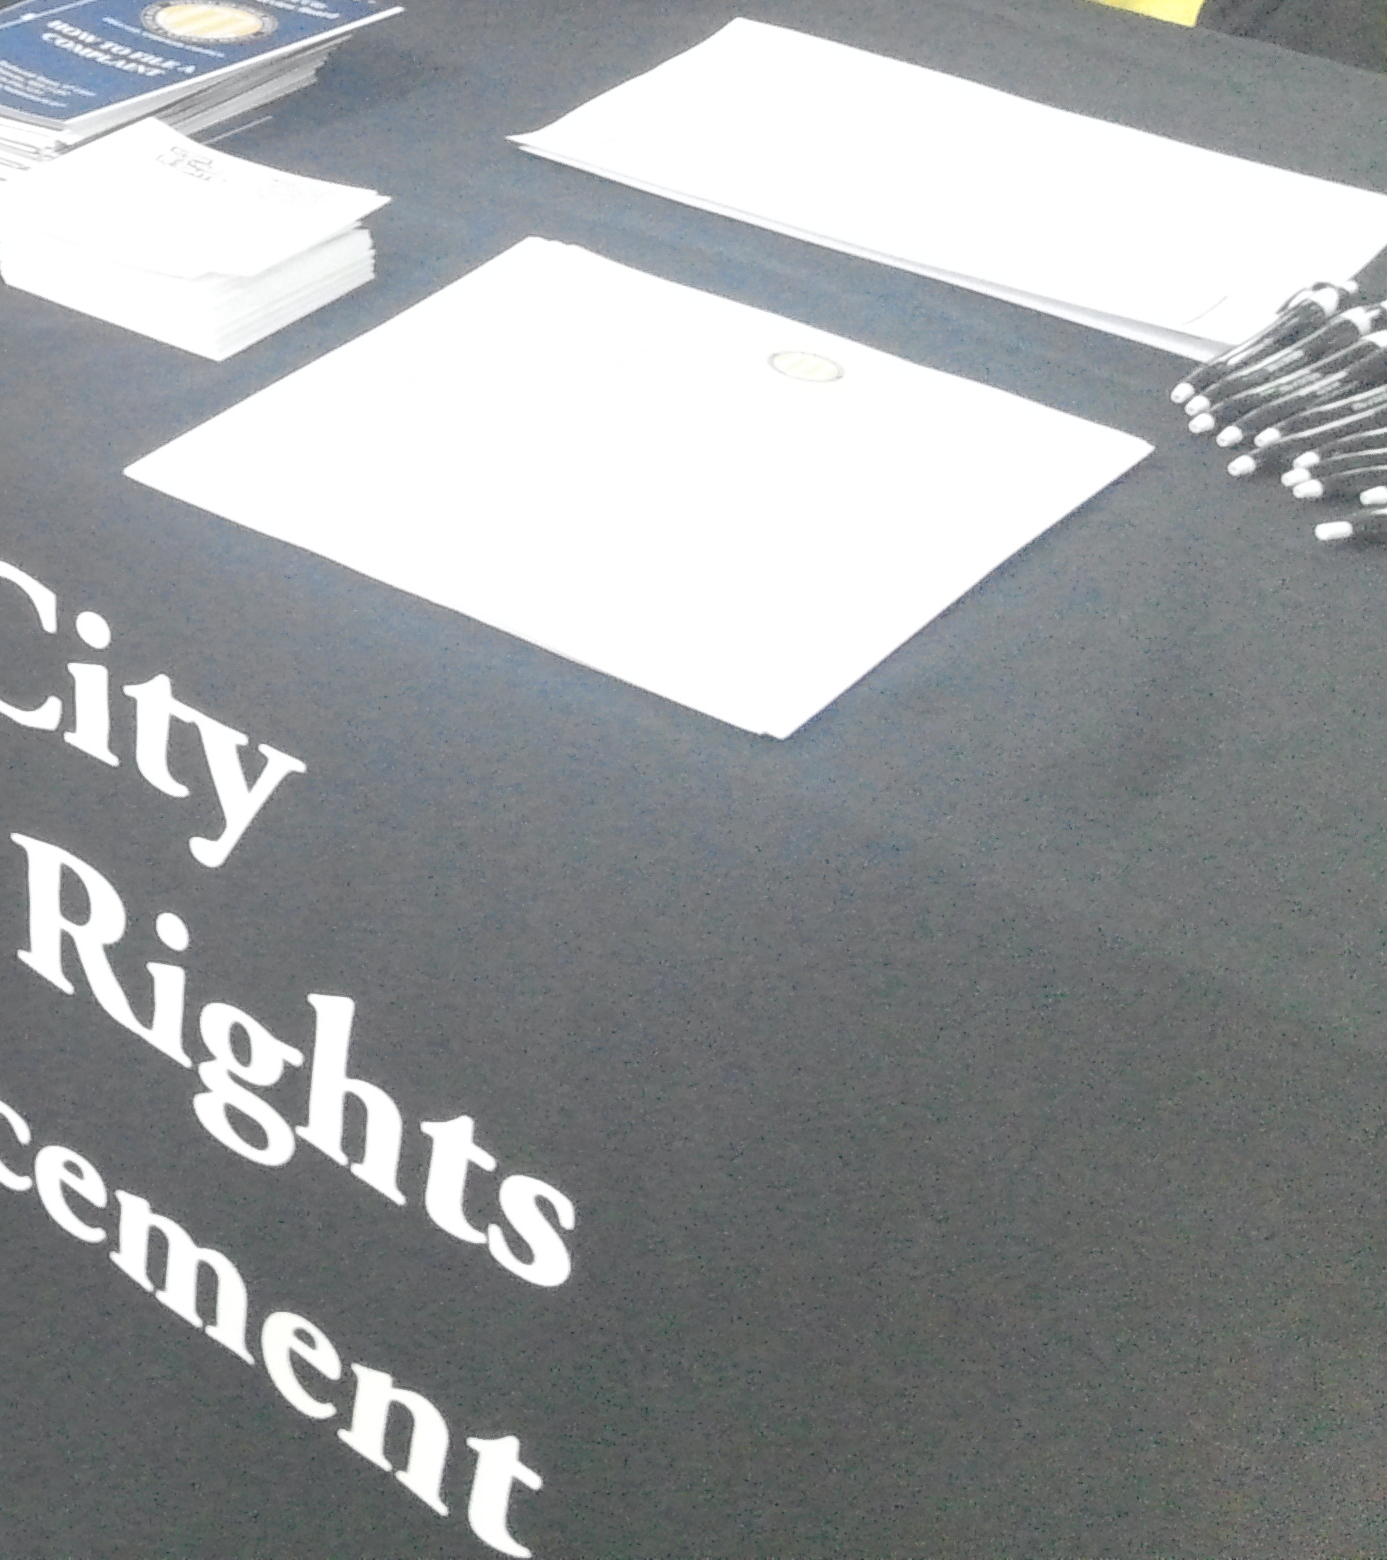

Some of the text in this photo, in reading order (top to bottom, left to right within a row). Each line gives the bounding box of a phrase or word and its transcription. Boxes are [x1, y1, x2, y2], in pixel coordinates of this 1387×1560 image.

[40, 31, 167, 77] COMPLAINT
[46, 19, 102, 44] HOW
[99, 40, 132, 56] TO
[128, 50, 181, 70] FILE
[9, 832, 576, 1288] Rights
